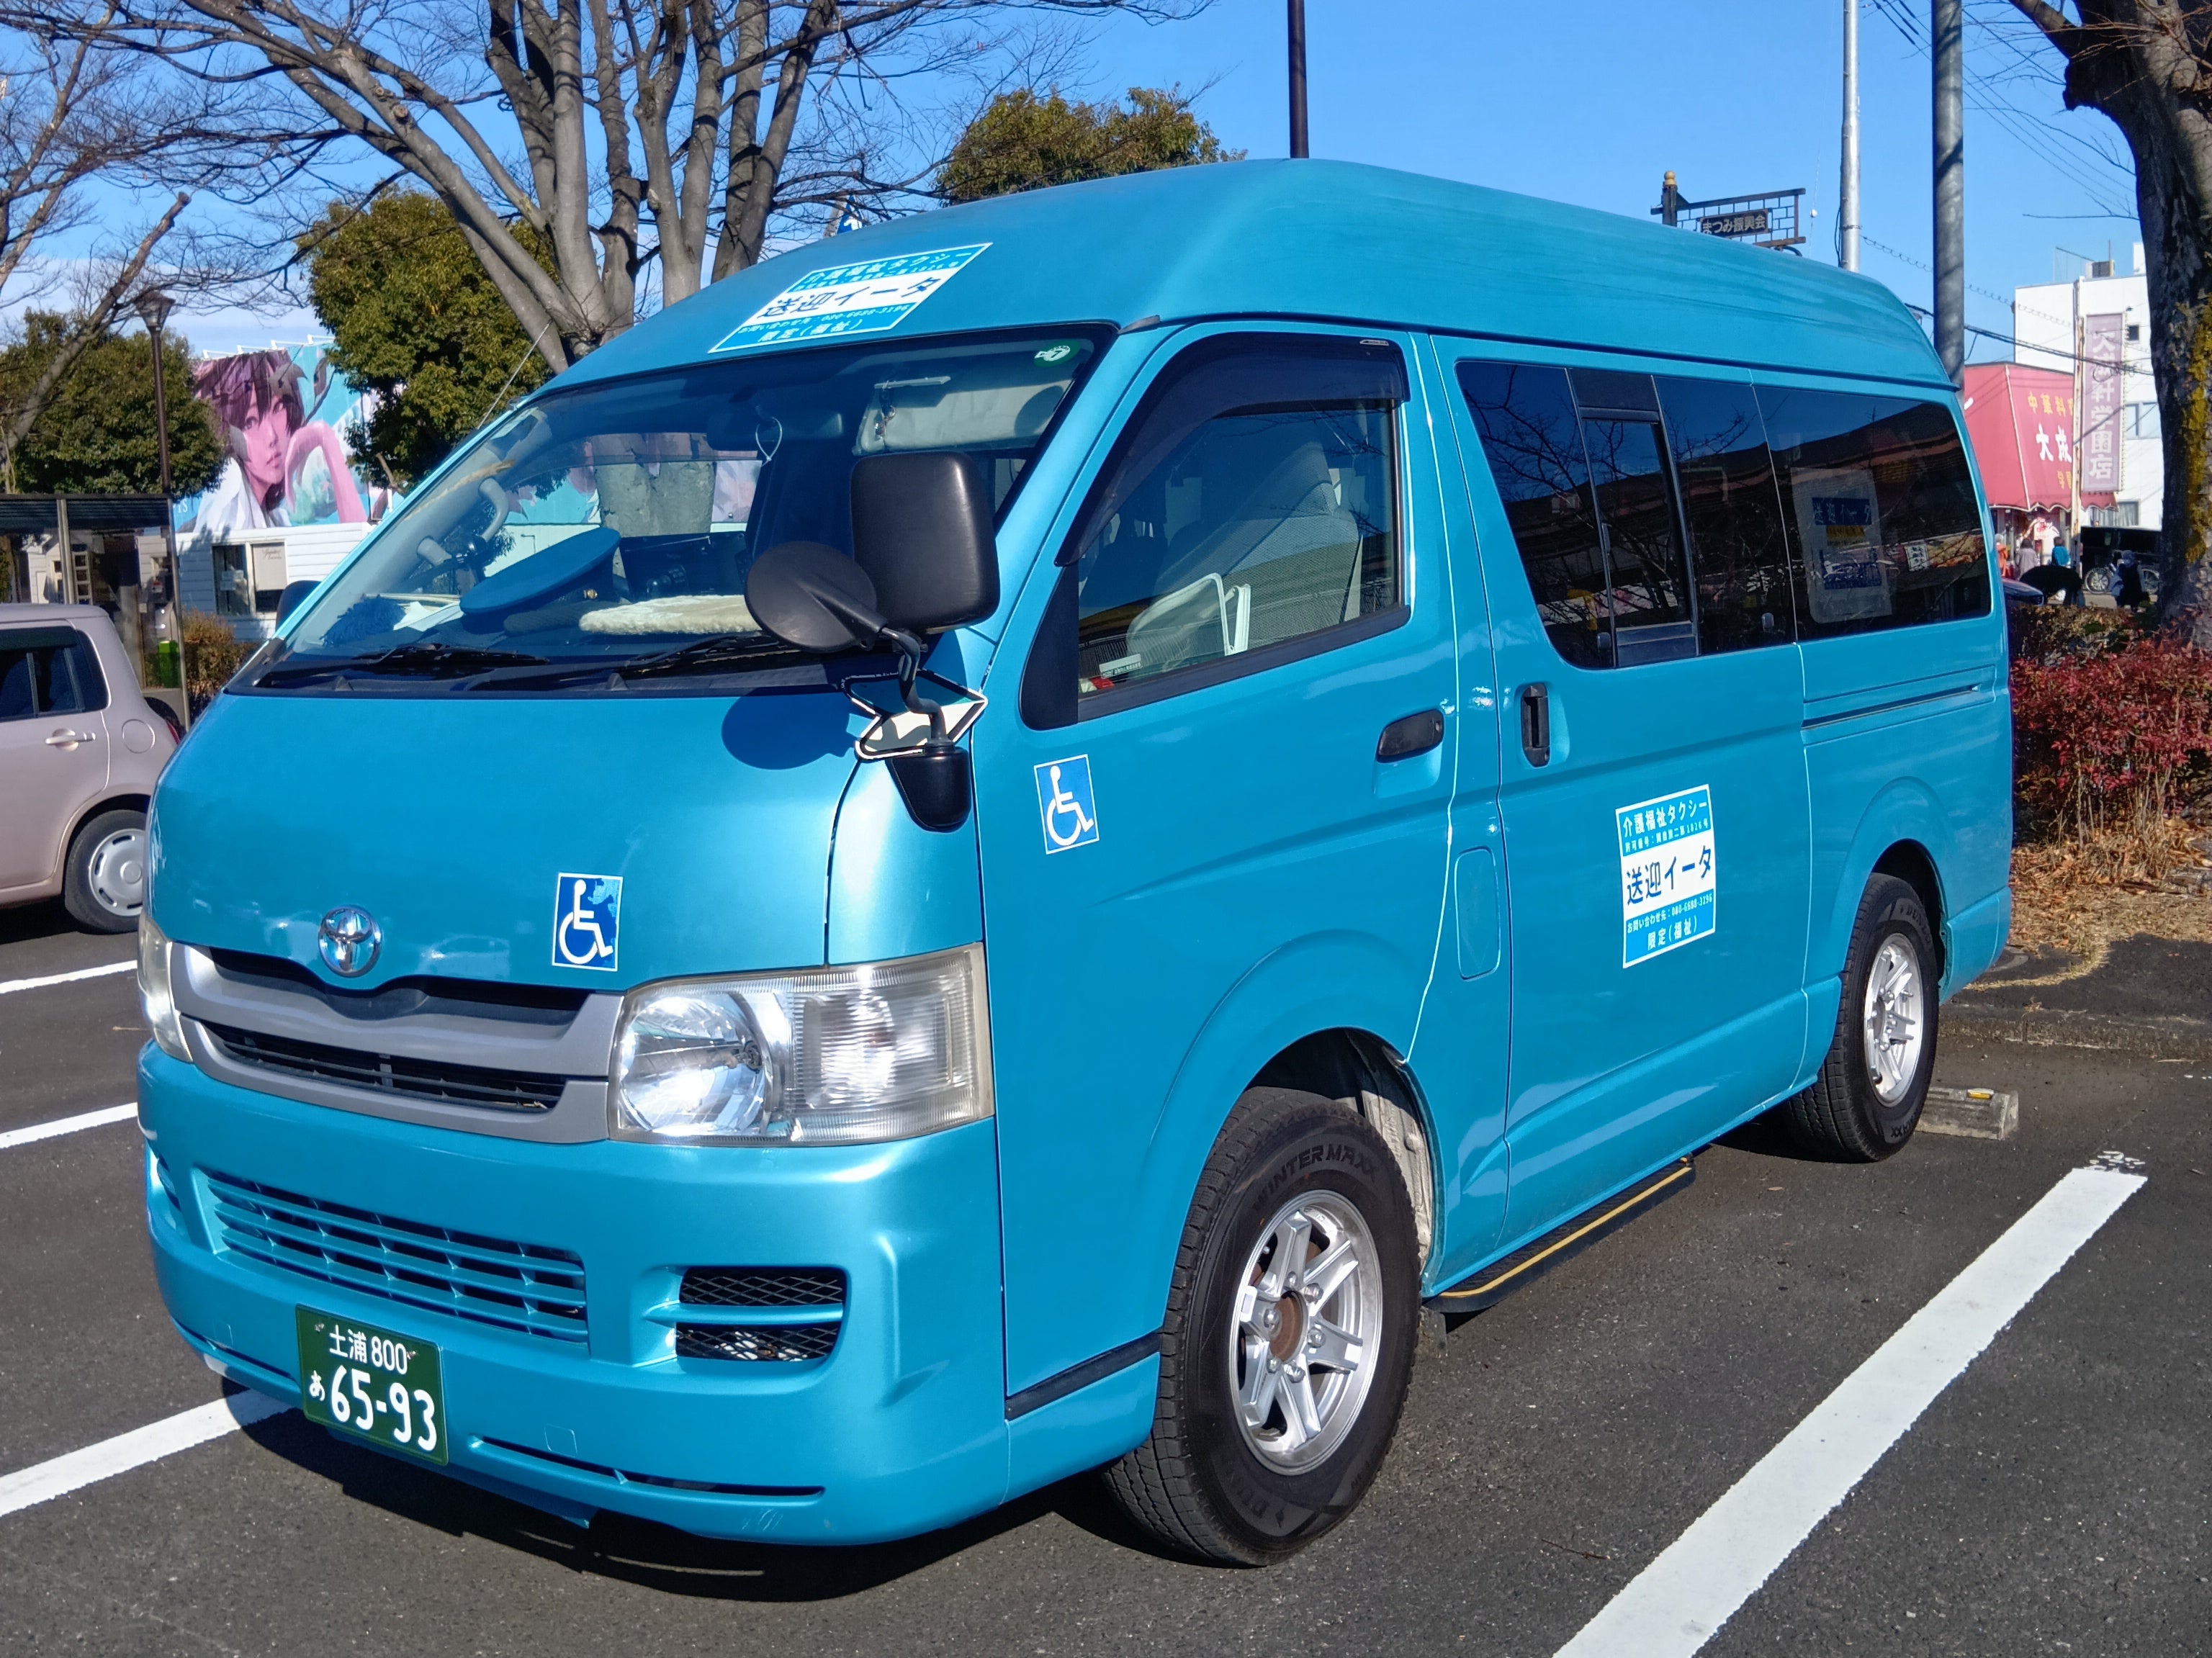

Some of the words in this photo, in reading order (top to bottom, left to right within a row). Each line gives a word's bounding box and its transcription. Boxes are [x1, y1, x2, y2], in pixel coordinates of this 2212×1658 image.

[804, 252, 972, 284] 介護福祉タクシー
[757, 277, 940, 319] 送迎イータ
[1622, 800, 1707, 837] 介護福祉タクシー
[1627, 845, 1712, 906] 送迎イータ
[1253, 1145, 1324, 1211] WINTER
[329, 1324, 367, 1364] 土浦
[371, 1336, 408, 1375] 800
[309, 1370, 325, 1401] あ
[331, 1364, 437, 1451] 65-93
